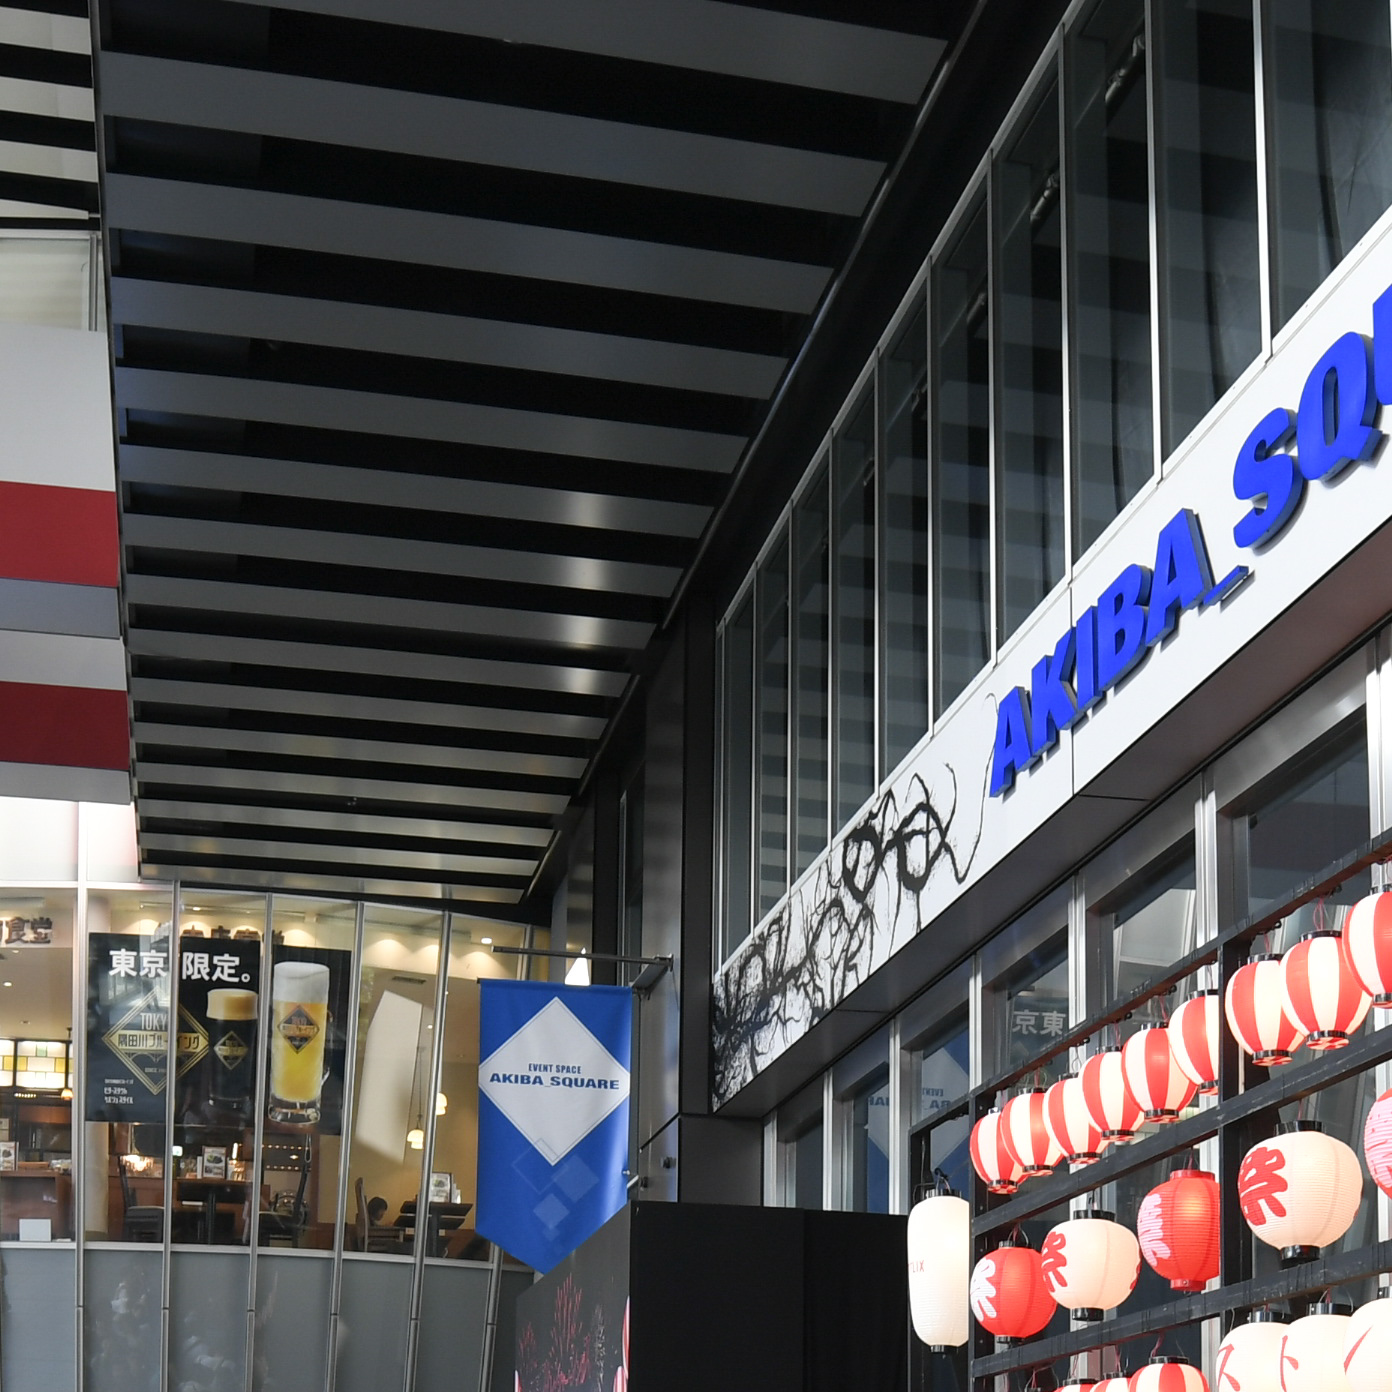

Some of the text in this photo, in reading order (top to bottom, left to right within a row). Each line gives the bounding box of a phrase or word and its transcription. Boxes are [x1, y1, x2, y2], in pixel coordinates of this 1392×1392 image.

[139, 1012, 168, 1031] TOKY
[528, 1062, 582, 1075] EVENT SPACE
[489, 1072, 620, 1091] AKIBA_SQUARE
[1238, 1146, 1288, 1226] 祭
[970, 1258, 997, 1322] 祭
